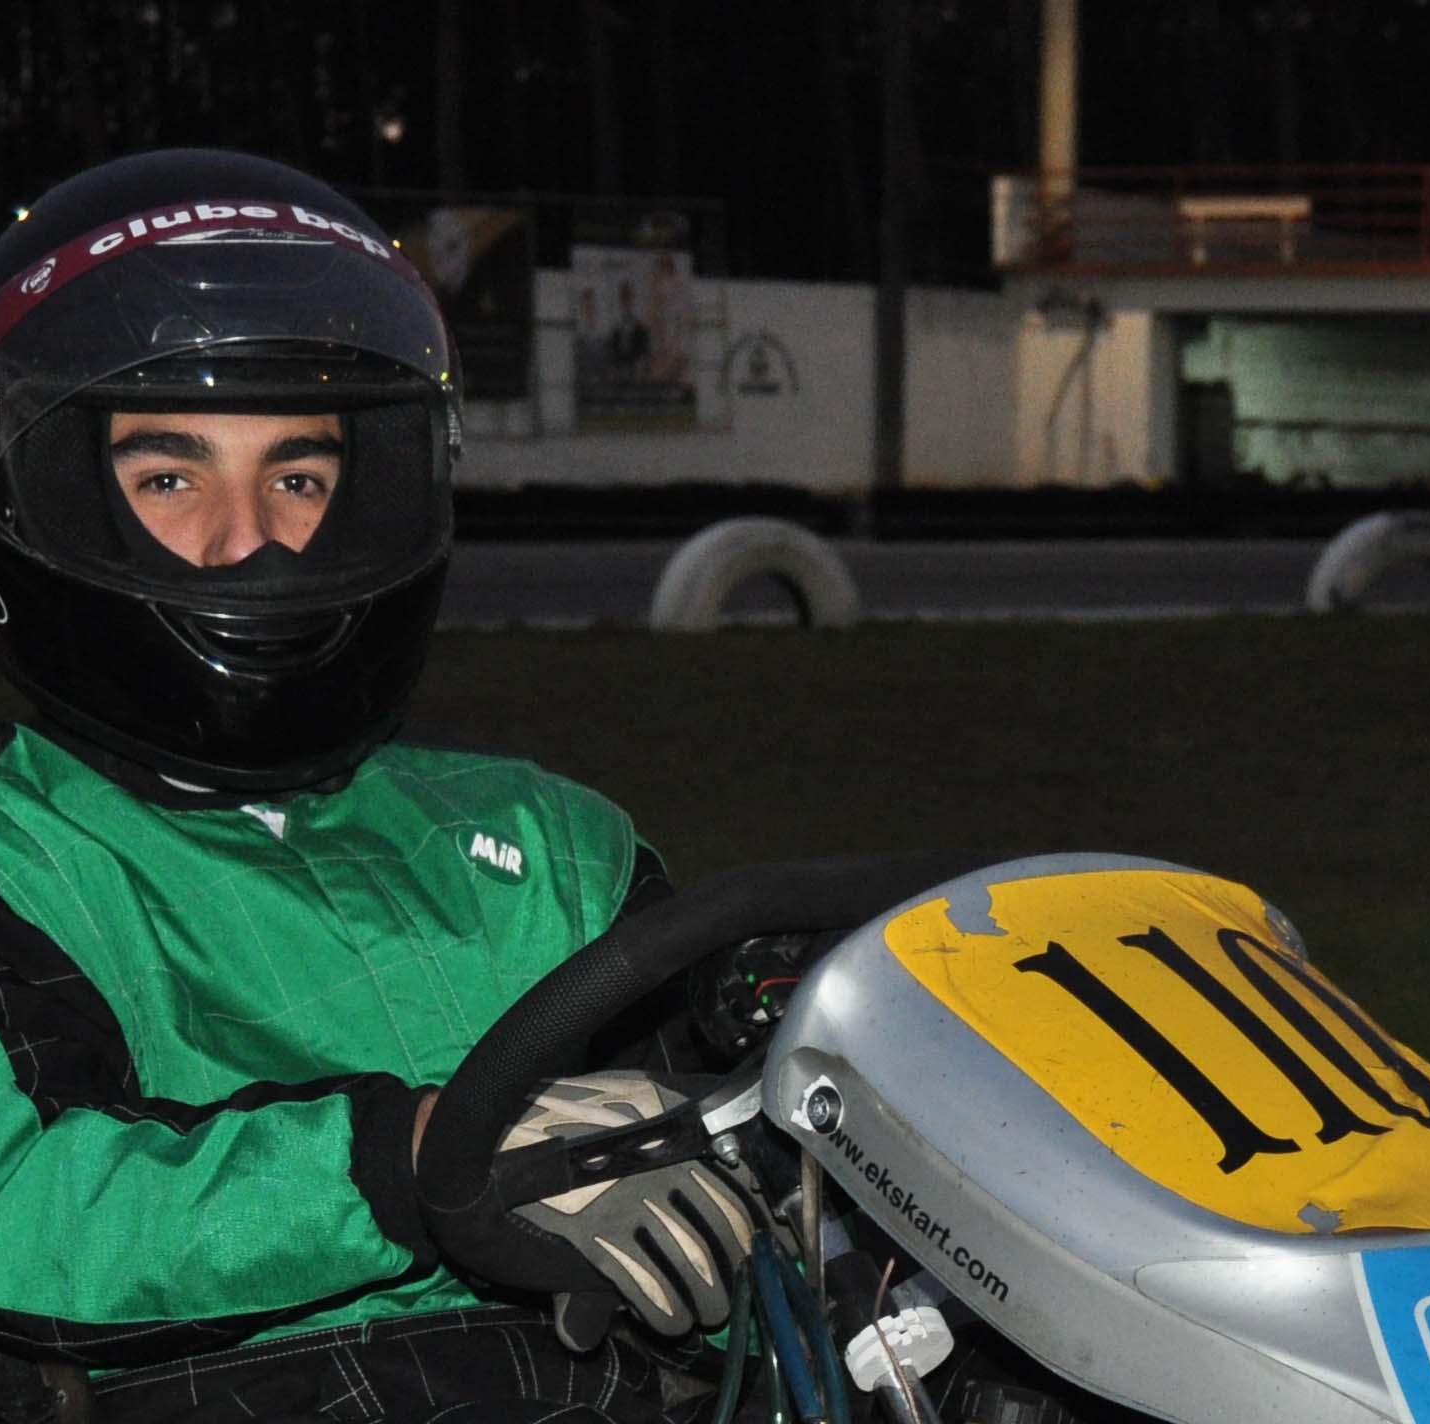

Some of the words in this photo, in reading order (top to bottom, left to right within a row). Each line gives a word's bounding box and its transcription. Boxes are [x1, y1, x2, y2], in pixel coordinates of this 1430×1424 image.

[89, 204, 278, 254] clube
[291, 205, 391, 259] bcp
[827, 1127, 1009, 1303] ww.ekskart.com
